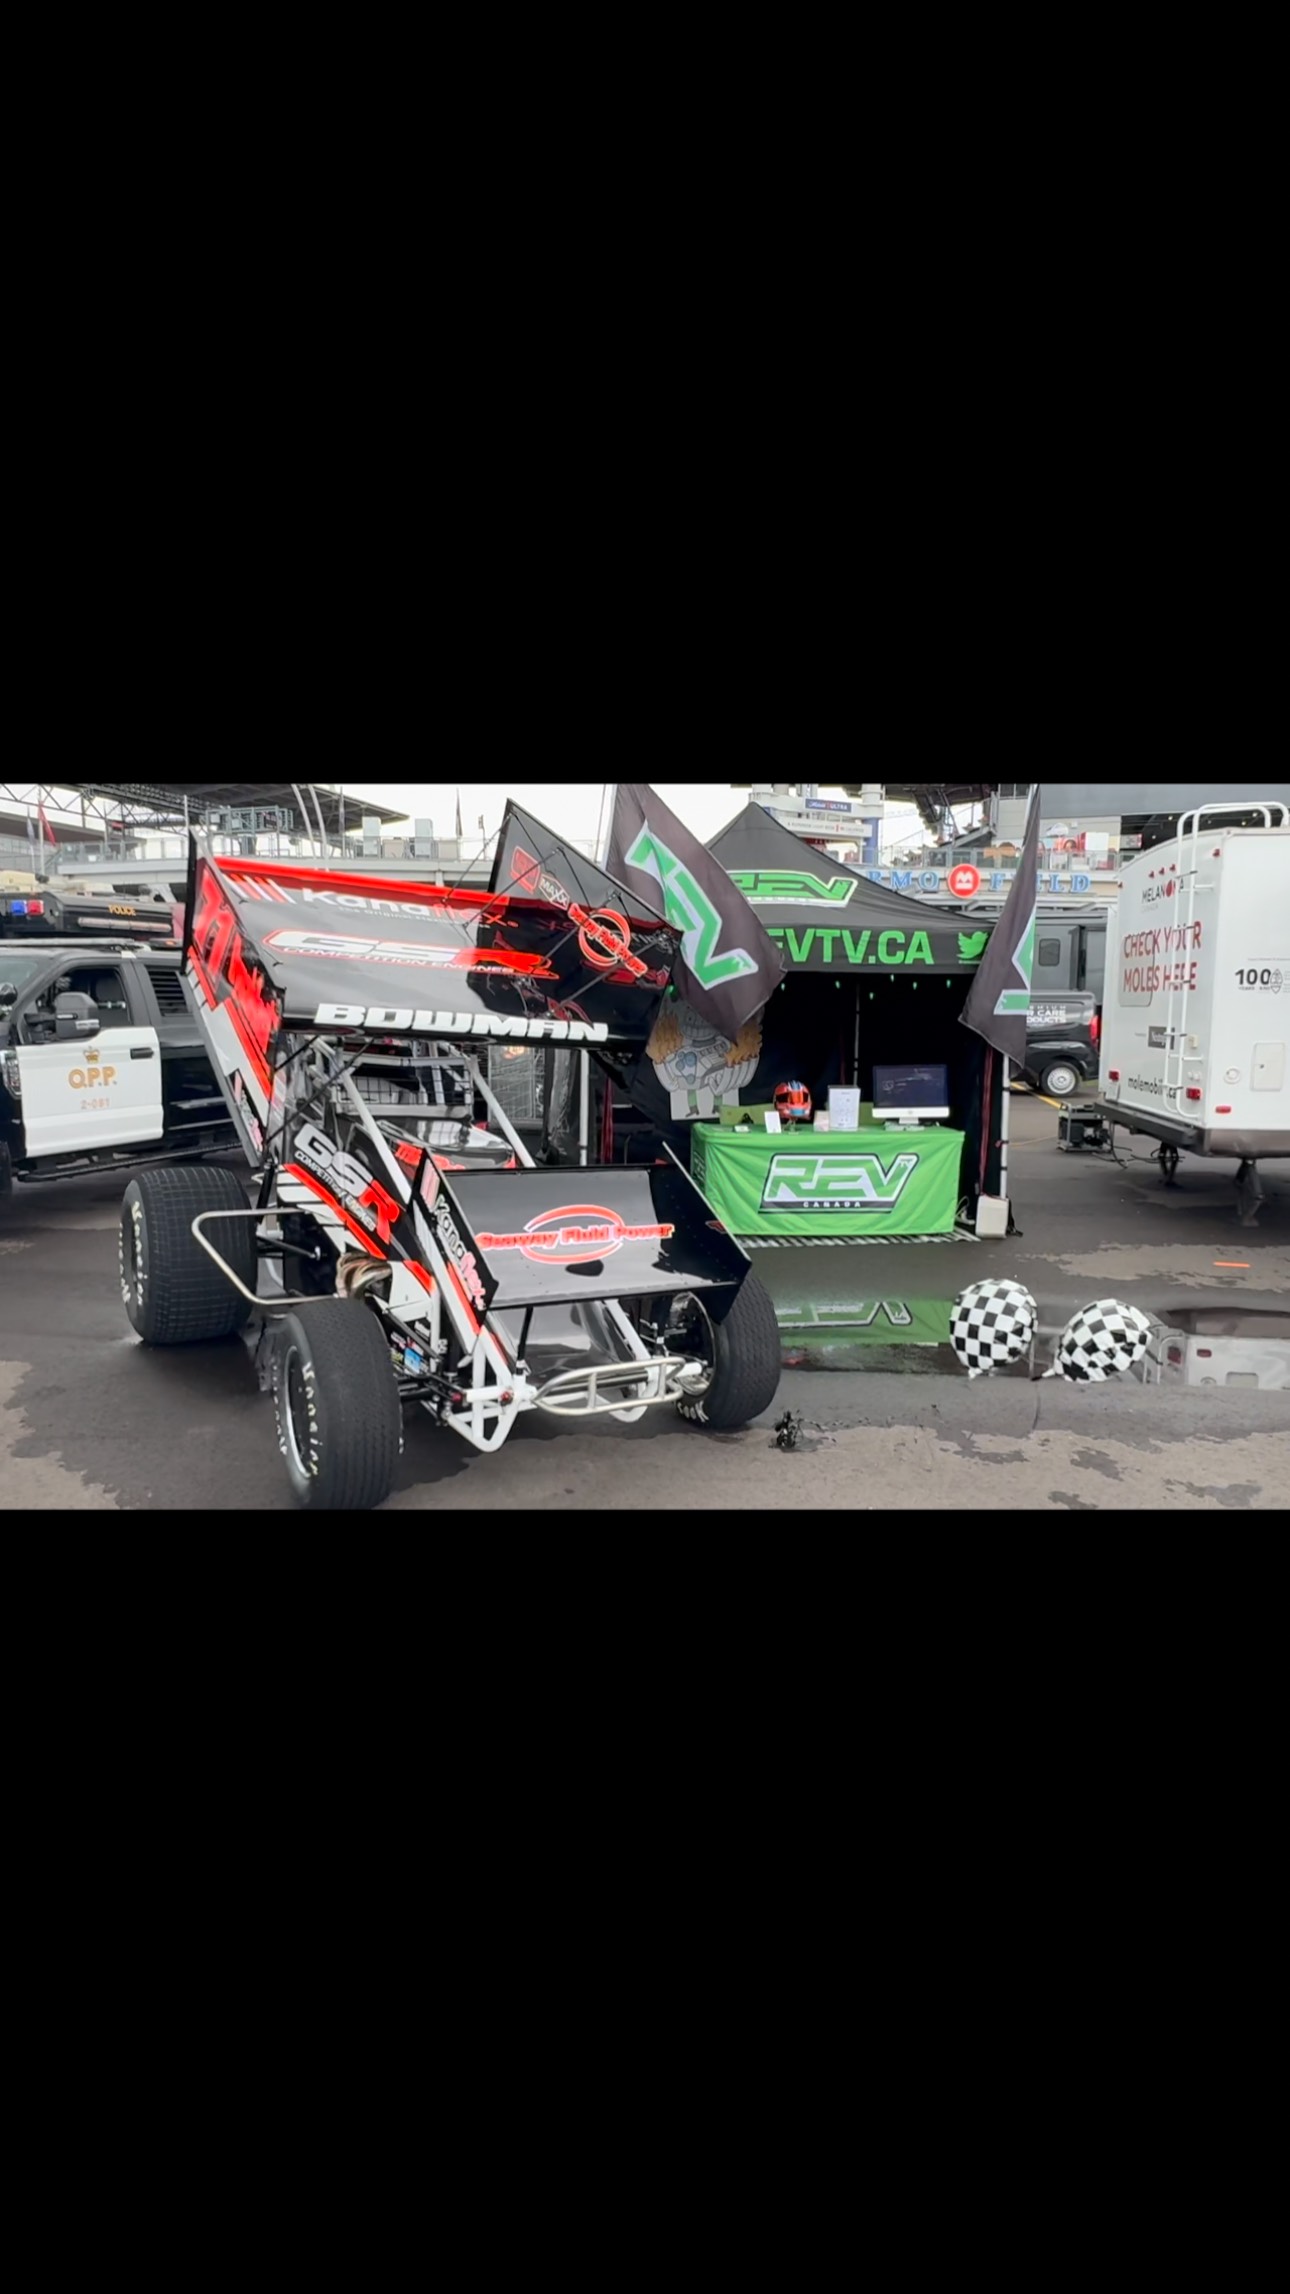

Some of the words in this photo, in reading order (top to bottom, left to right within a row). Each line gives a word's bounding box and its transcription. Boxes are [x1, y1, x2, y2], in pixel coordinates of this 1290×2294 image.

[991, 873, 1091, 892] FLD
[108, 904, 137, 917] POLICE
[1124, 930, 1161, 958] CHECK
[1124, 966, 1160, 993] MOLES
[1235, 969, 1271, 985] 100
[314, 1003, 608, 1042] BOWMAN
[294, 1123, 400, 1245] GSR
[764, 1155, 917, 1202] REV
[560, 1225, 610, 1245] Fluid
[613, 1223, 675, 1240] Power
